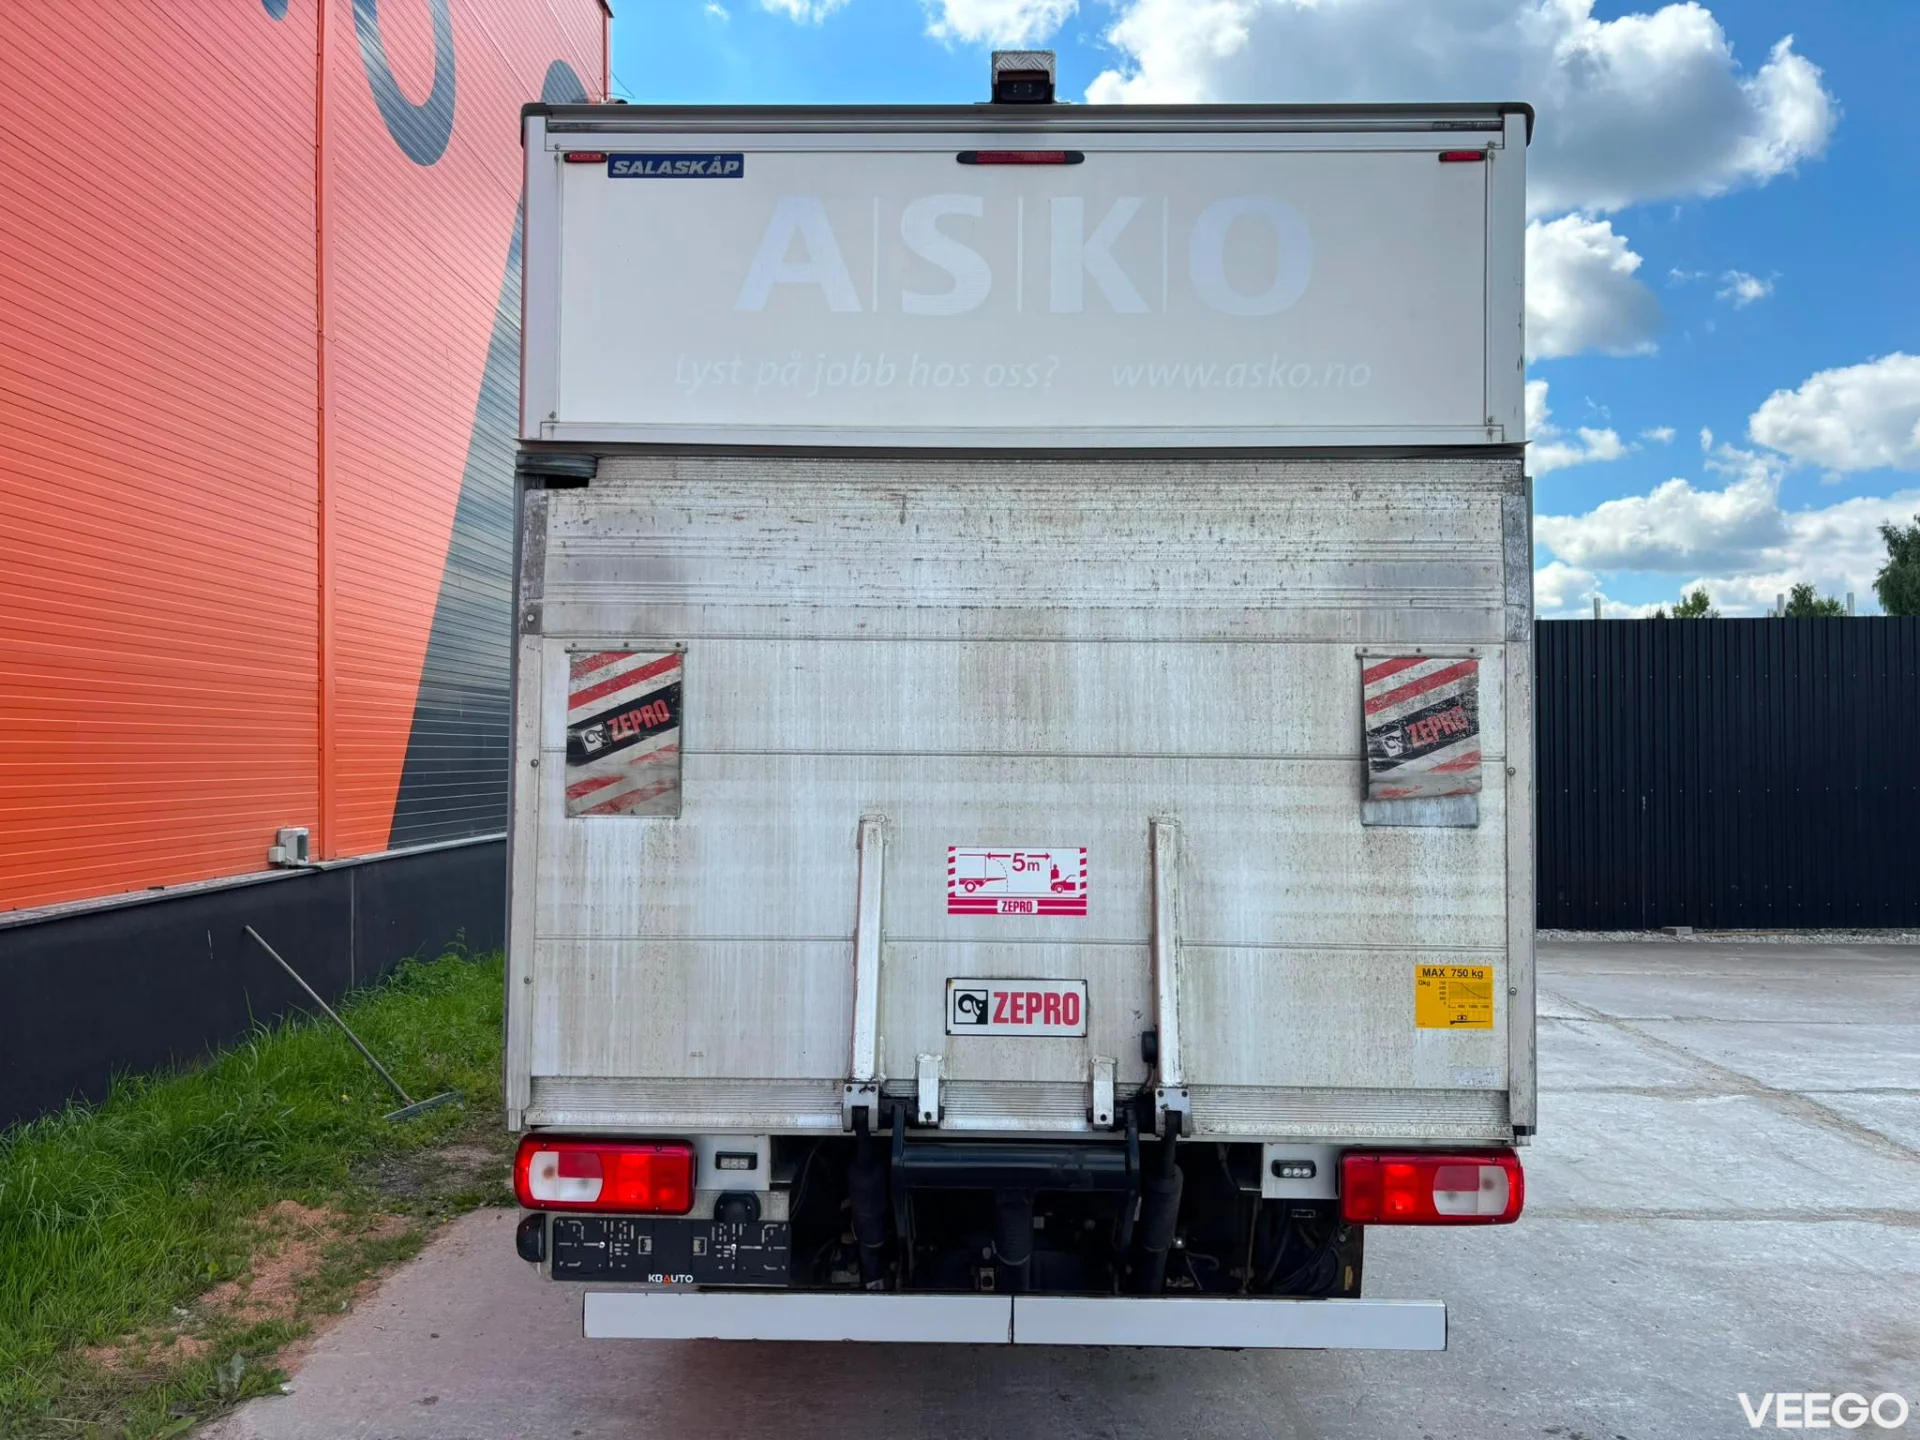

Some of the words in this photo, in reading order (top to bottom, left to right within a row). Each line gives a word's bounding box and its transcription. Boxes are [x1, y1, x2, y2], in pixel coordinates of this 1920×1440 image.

[612, 155, 739, 175] SALASKÅP
[674, 352, 744, 394] Lyst
[753, 348, 801, 394] på
[807, 353, 896, 396] jobb
[908, 353, 971, 388] hos
[983, 354, 1060, 389] oss?
[1111, 353, 1372, 389] www.asko.no
[607, 699, 670, 742] ZEPRO
[1405, 704, 1470, 749] ZEPRO
[1001, 900, 1033, 913] ZEPRO
[1422, 968, 1446, 977] MAX
[1451, 968, 1469, 977] 750
[1472, 969, 1484, 979] kg
[992, 991, 1080, 1026] ZEPRO
